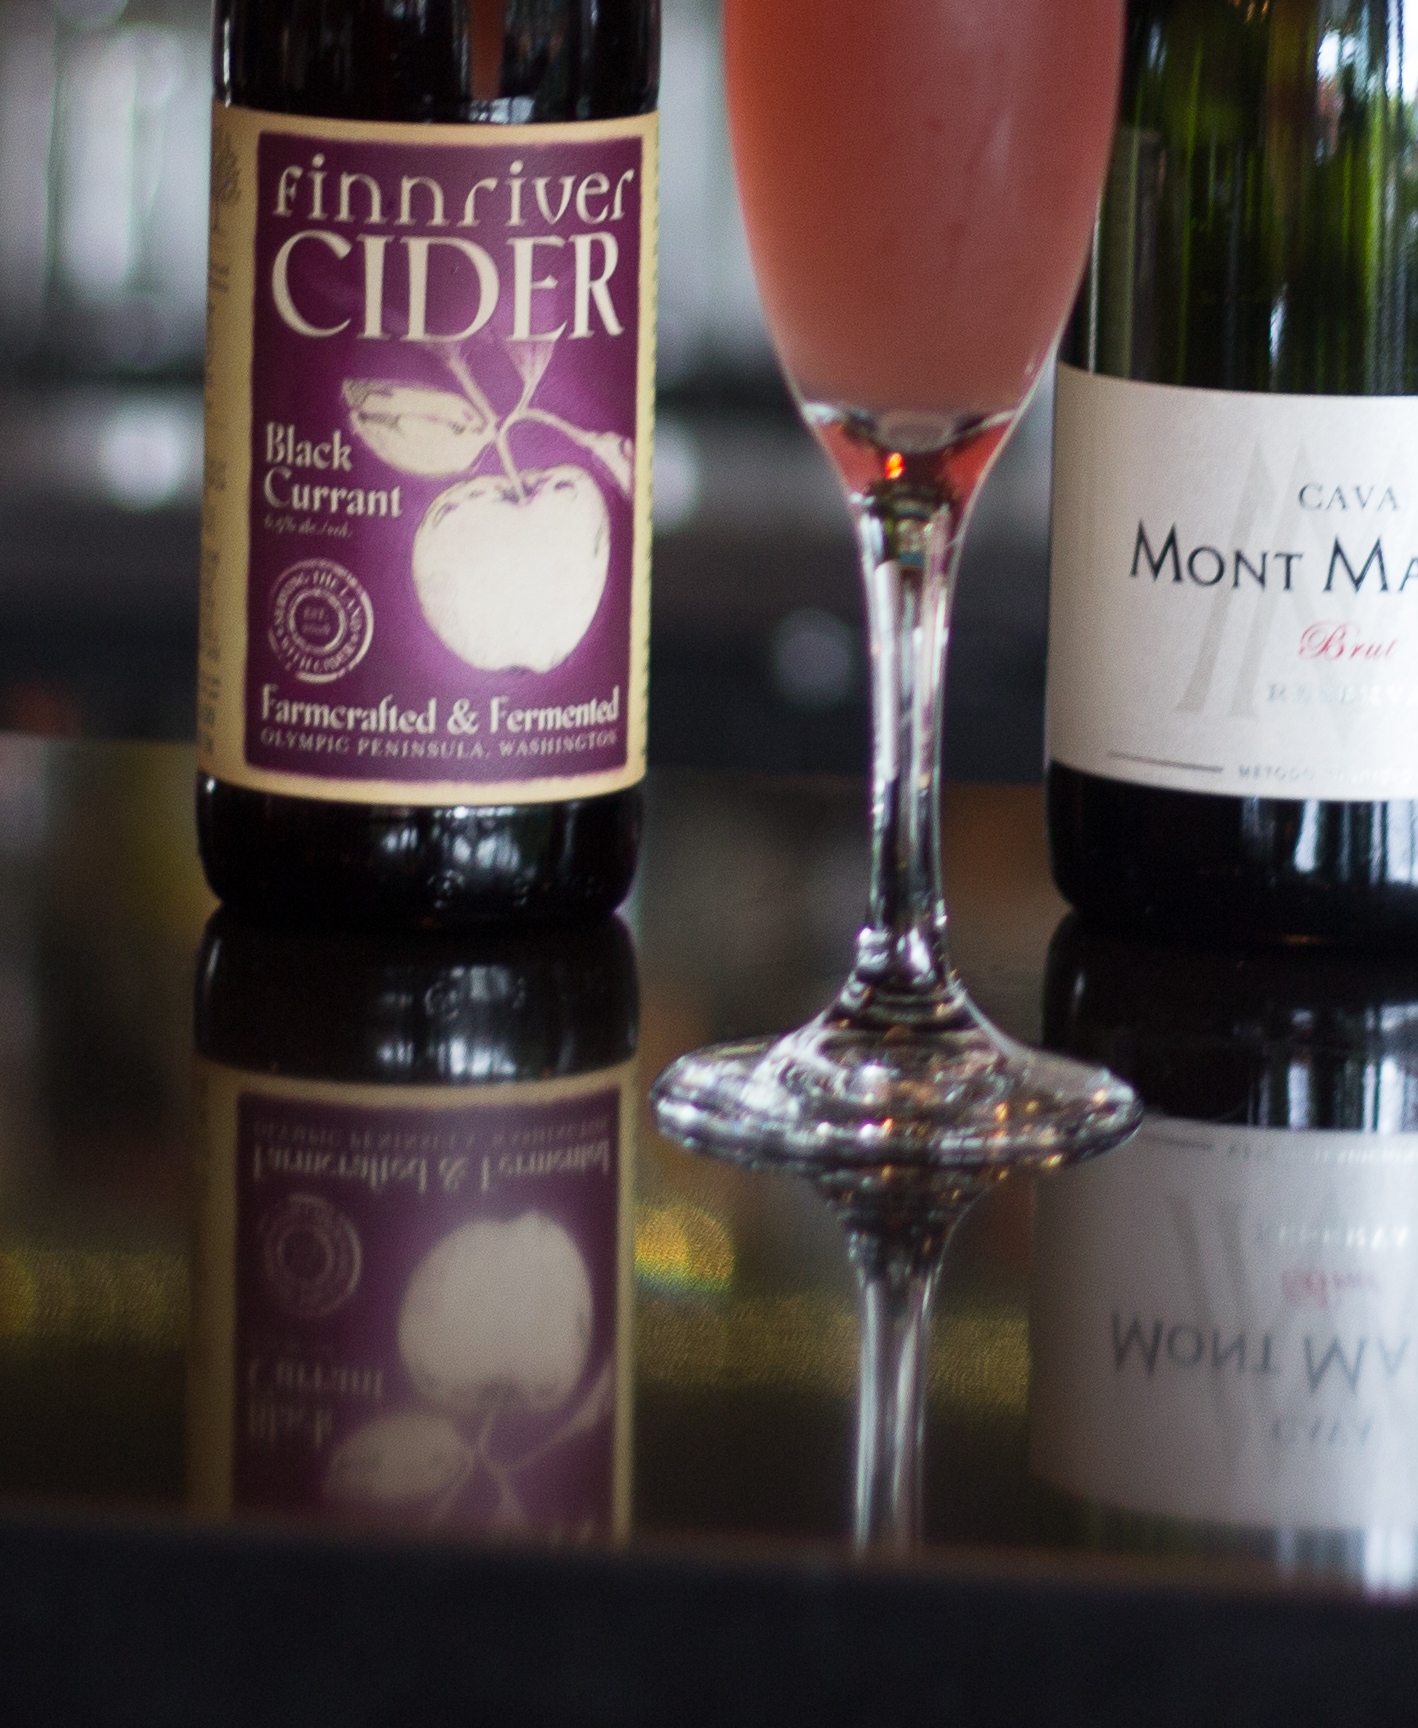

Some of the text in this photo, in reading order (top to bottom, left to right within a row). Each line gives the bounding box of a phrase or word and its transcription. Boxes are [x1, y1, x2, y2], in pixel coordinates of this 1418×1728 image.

[271, 228, 626, 343] CIDER
[265, 420, 353, 471] Black
[263, 465, 403, 519] Currant
[1298, 483, 1399, 512] CAVA
[1131, 519, 1304, 593] MONT
[1298, 620, 1399, 661] Brut
[262, 682, 620, 736] Farmcrafted & Fermented
[260, 726, 350, 755] OLYMPIC
[499, 728, 619, 758] WASHINGTON
